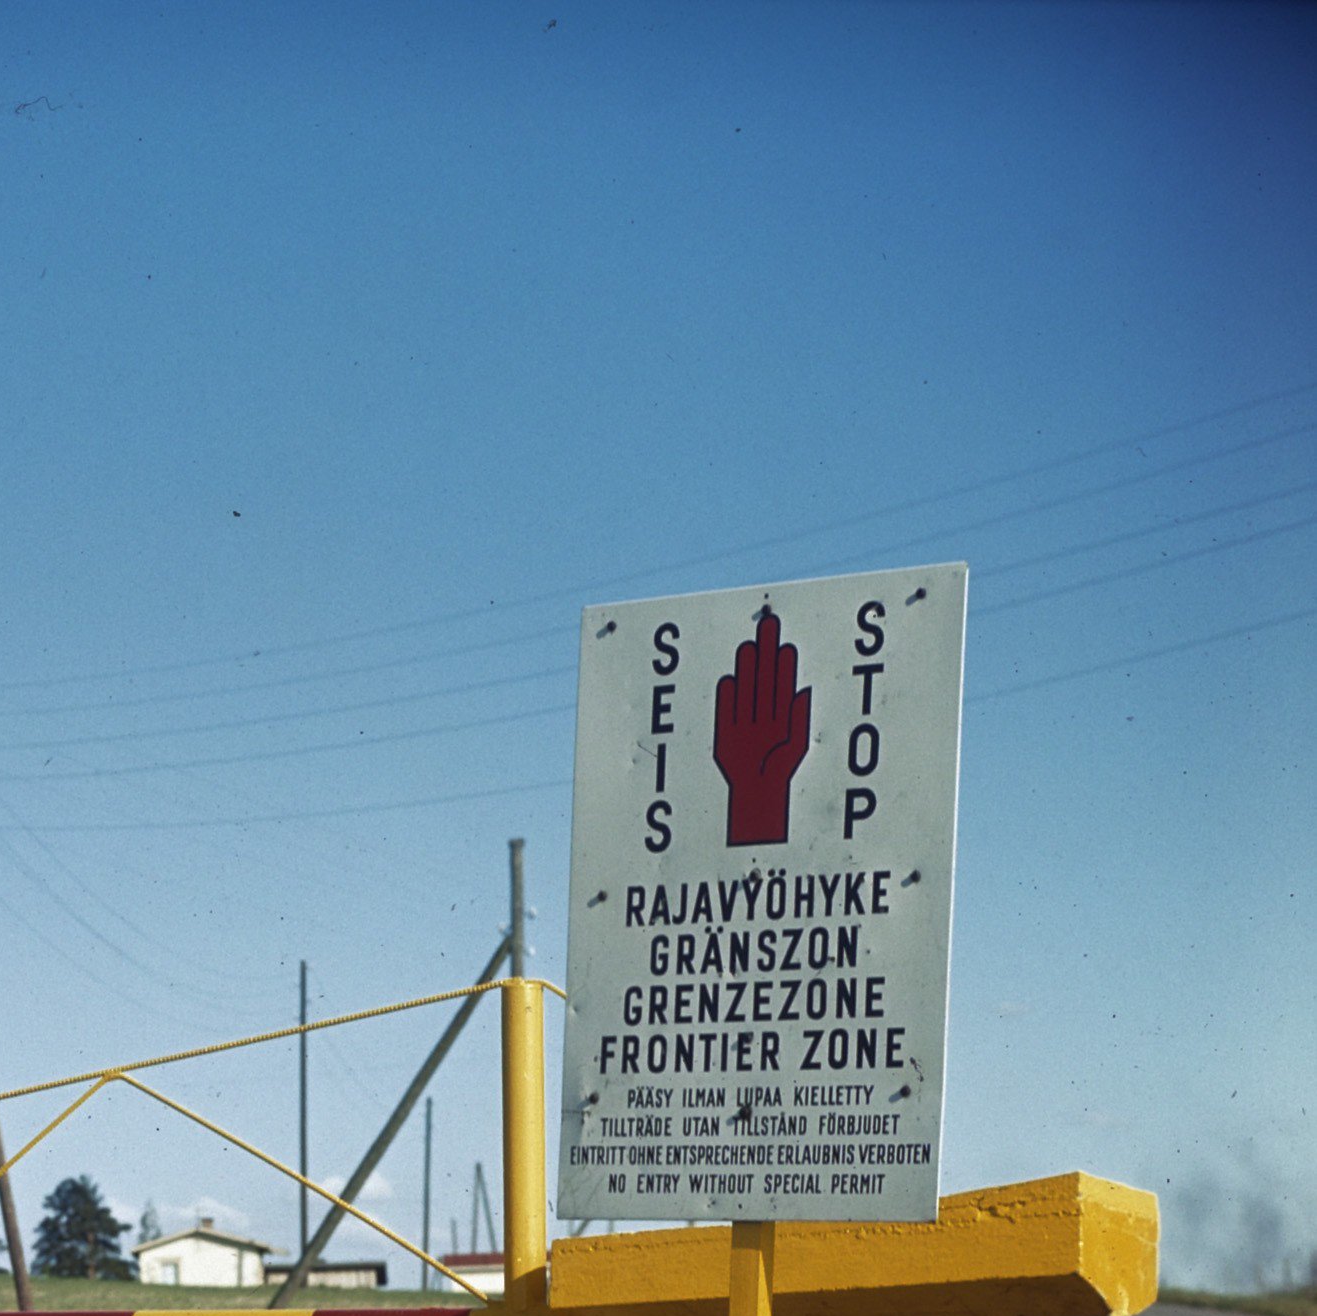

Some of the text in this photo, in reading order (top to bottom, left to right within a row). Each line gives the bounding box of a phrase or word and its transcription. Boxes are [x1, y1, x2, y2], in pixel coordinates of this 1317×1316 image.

[644, 622, 680, 853] SEIS
[843, 600, 885, 840] STOP
[625, 868, 891, 927] RAJAVYÖHYKE
[649, 925, 859, 975] GRÄNSZON
[623, 976, 885, 1026] GRENZEZONE
[600, 1027, 906, 1074] FRONTIER ZONE
[628, 1084, 875, 1109] PÄÄSY ILMAN LUPAA KIELLETTY
[600, 1112, 900, 1138] TILLTRÄDE UTAN TILLSTÅND FÖRBJUDET
[570, 1143, 931, 1165] EINTRITT OHNE ENTSPRECHENDE ERLAUBNIS VERBOTEN
[608, 1173, 885, 1195] NO ENTRY WITHOUT SPECIAL PERMIT
